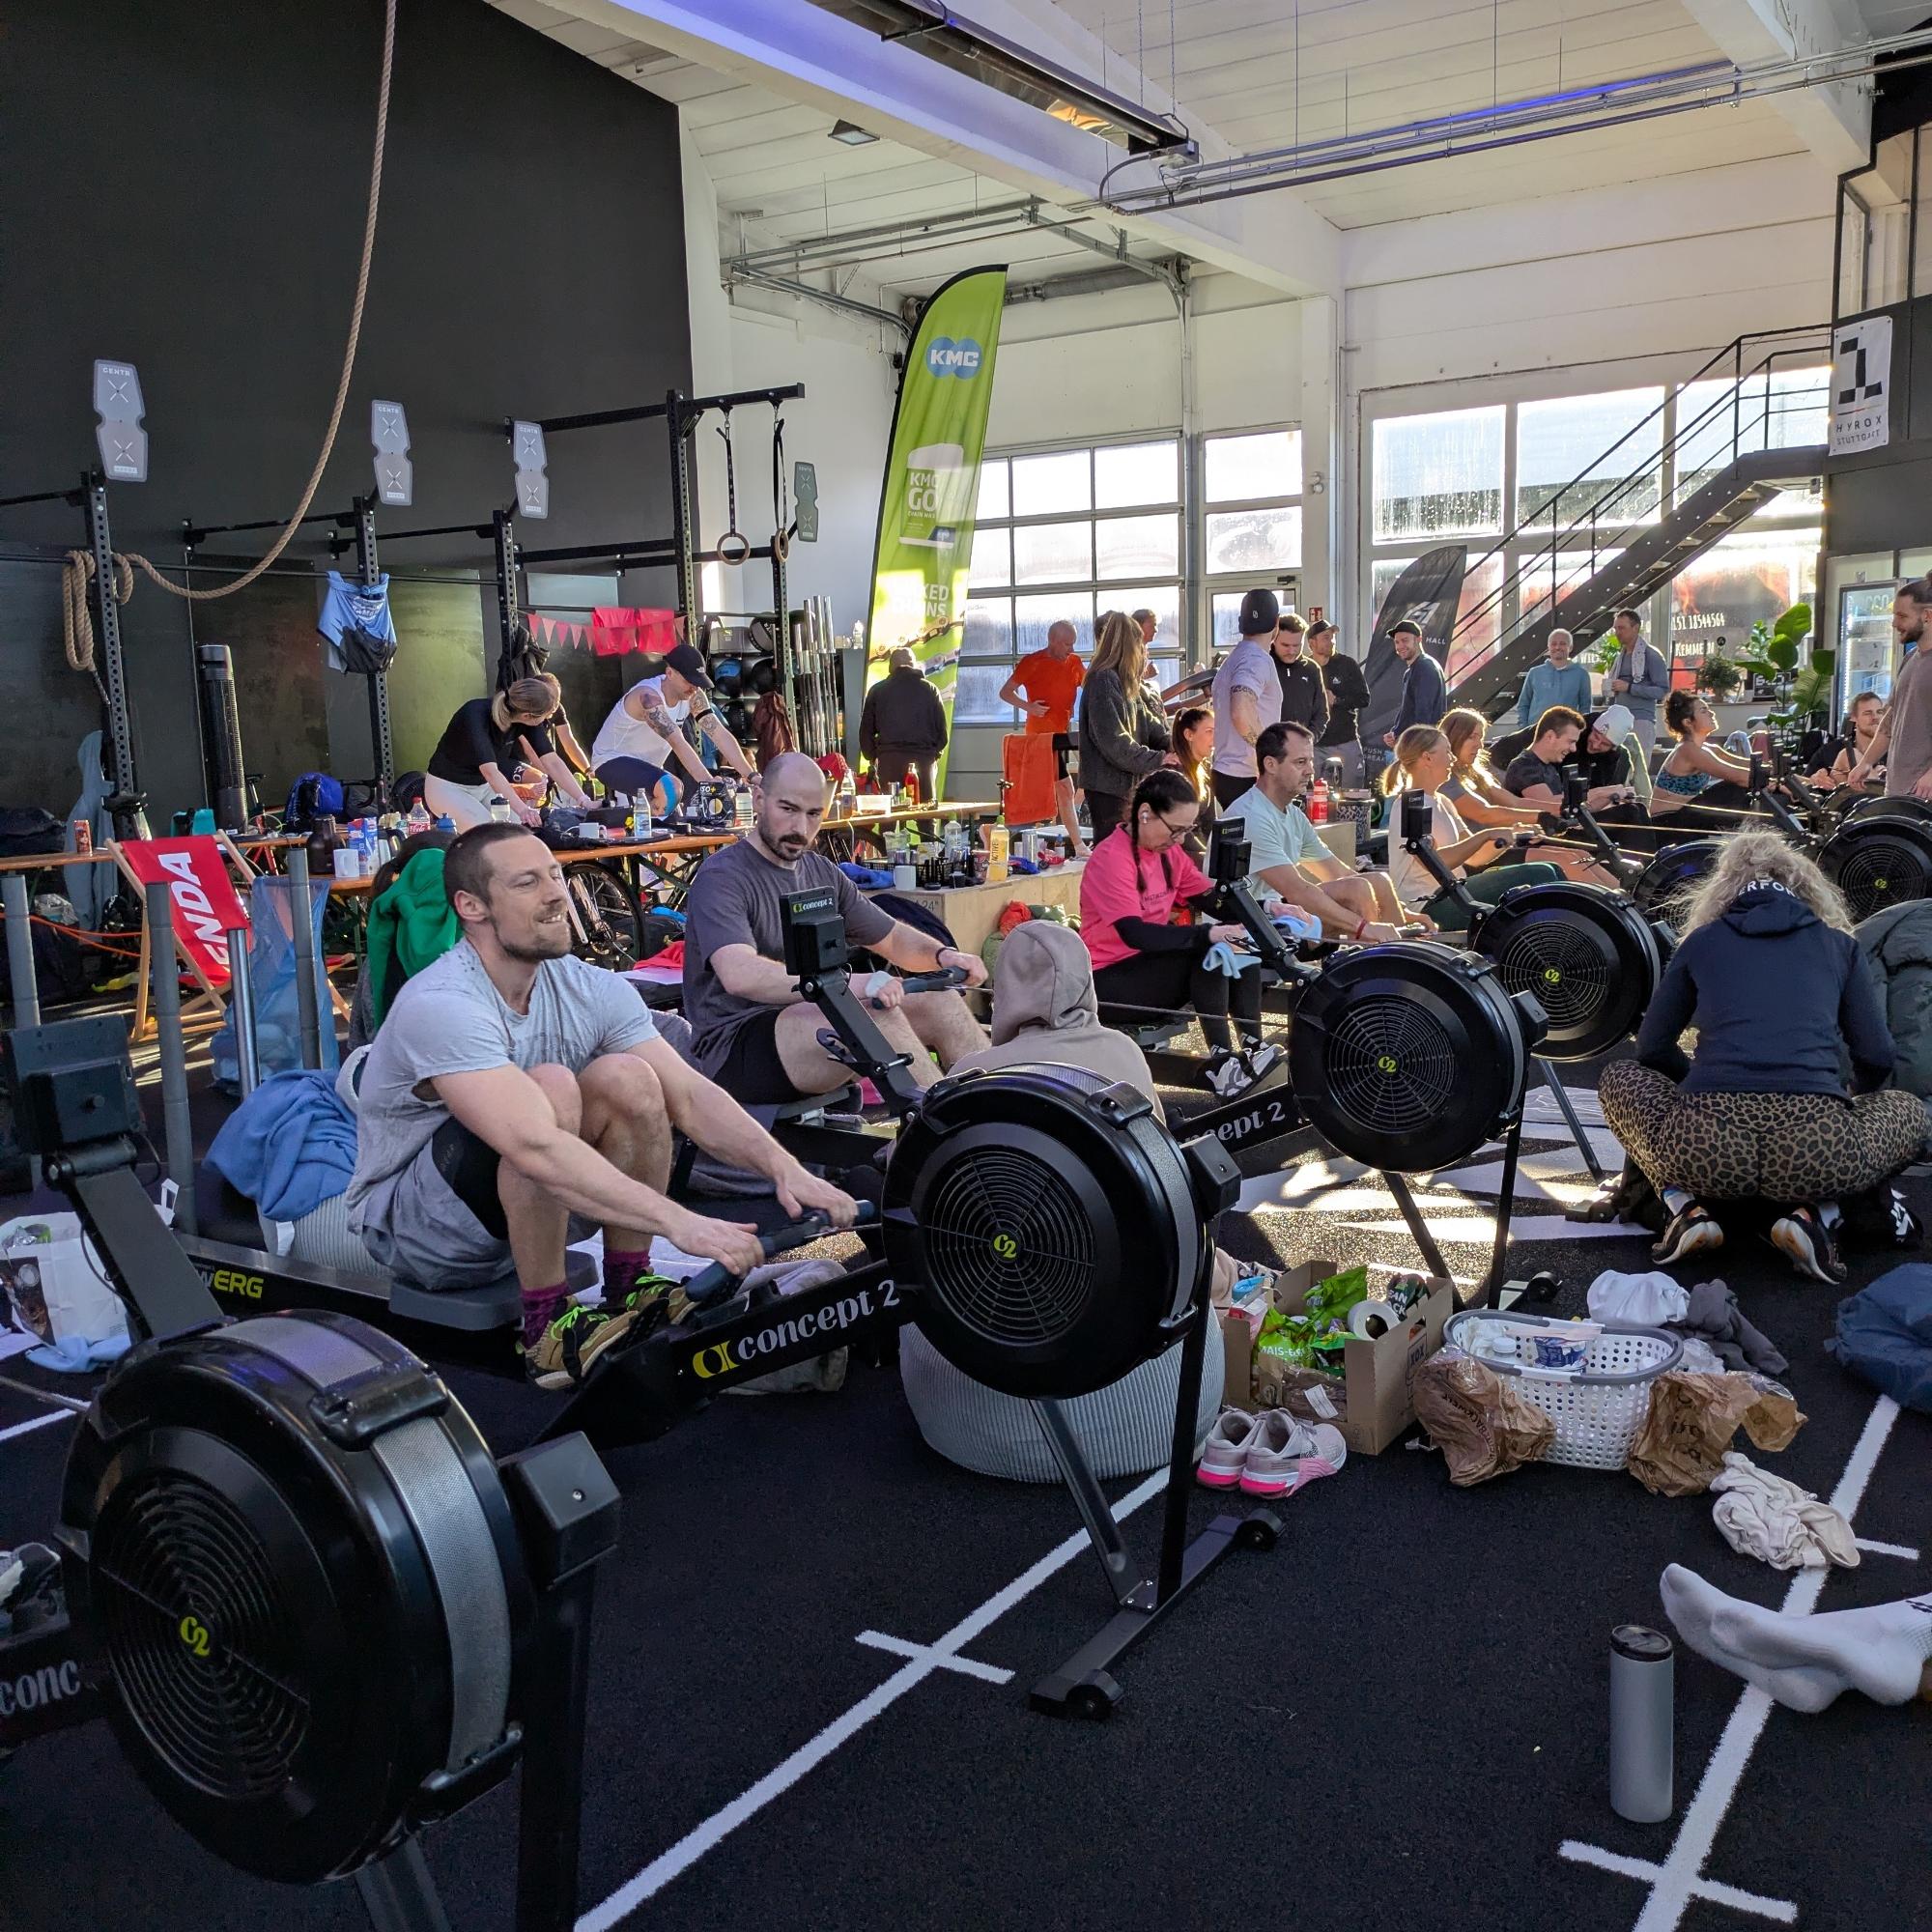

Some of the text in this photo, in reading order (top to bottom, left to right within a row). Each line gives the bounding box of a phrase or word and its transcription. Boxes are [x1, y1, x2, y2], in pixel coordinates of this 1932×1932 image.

[930, 349, 979, 367] KMC
[102, 367, 130, 376] CENTR
[1836, 415, 1882, 433] HYROX
[908, 487, 939, 512] GO
[1425, 637, 1446, 645] HALL
[803, 899, 828, 911] concept
[1378, 1056, 1397, 1072] C2
[1266, 1101, 1286, 1122] 2
[993, 1234, 1017, 1259] C2
[737, 1279, 900, 1360] concept 2
[180, 1615, 211, 1657] C2
